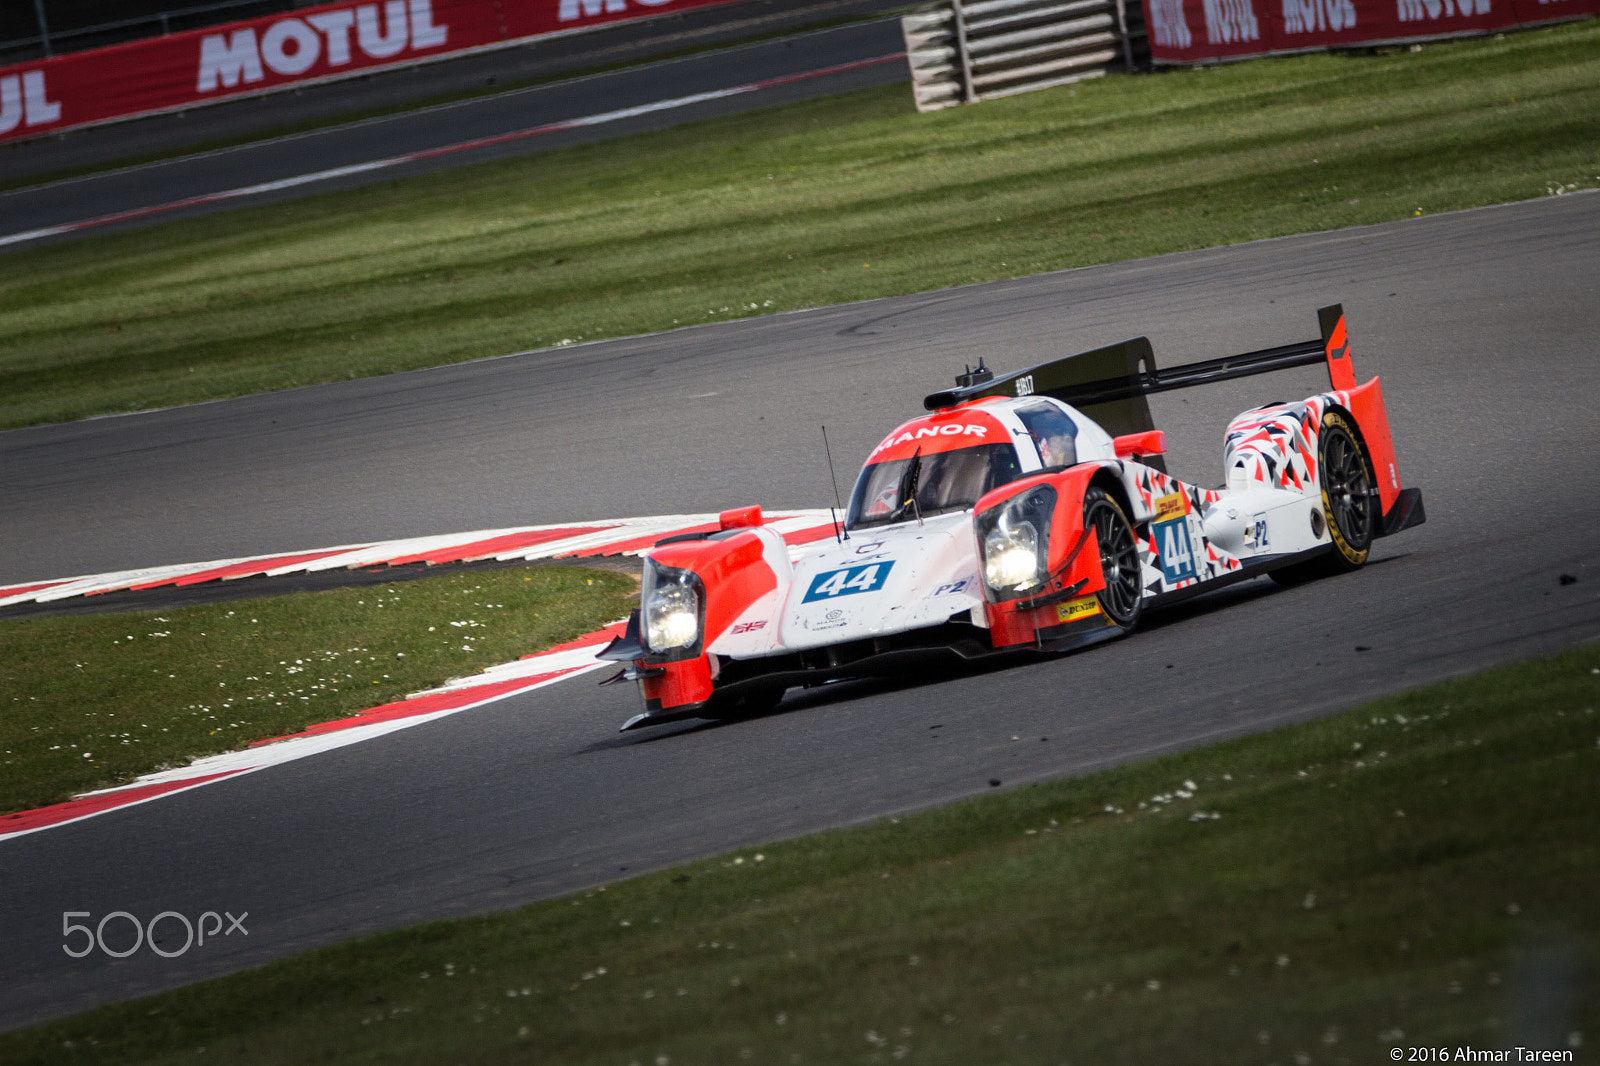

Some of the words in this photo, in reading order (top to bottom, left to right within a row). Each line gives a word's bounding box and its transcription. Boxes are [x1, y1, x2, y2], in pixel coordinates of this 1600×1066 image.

[197, 0, 448, 93] MOTUL
[873, 424, 988, 457] MANOR
[1164, 522, 1192, 575] 44
[1255, 520, 1268, 548] P2
[815, 564, 880, 596] 44
[934, 580, 967, 596] P2
